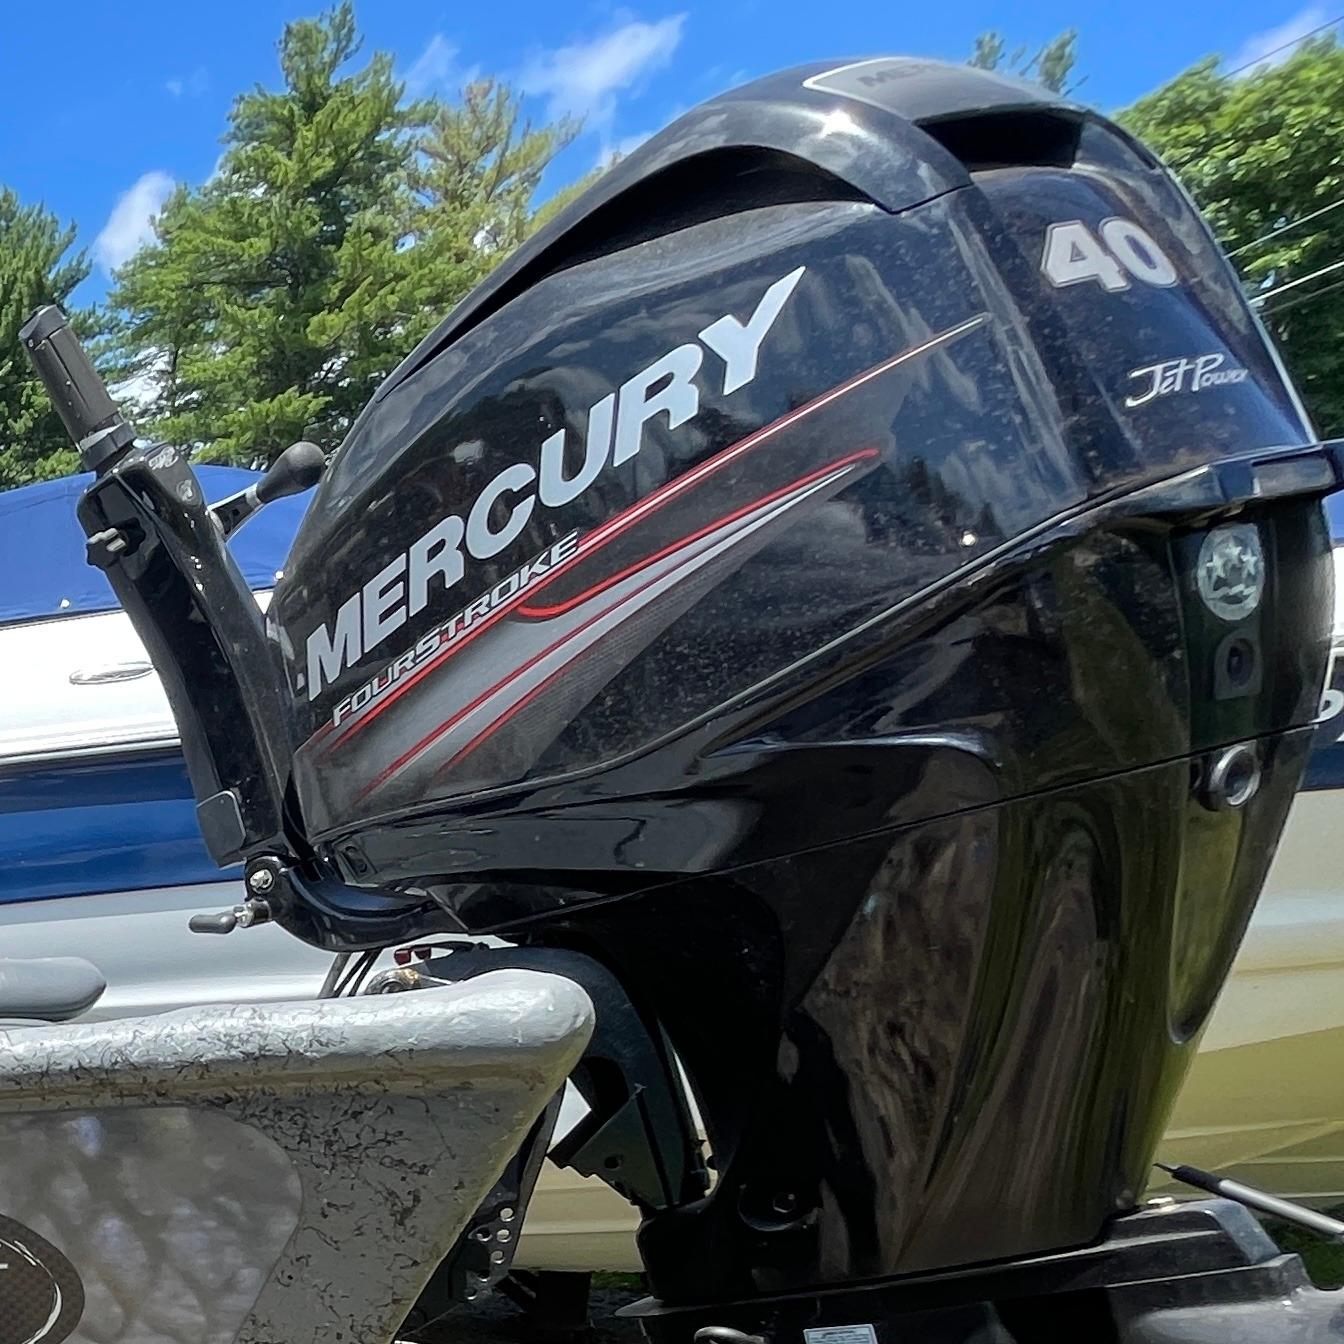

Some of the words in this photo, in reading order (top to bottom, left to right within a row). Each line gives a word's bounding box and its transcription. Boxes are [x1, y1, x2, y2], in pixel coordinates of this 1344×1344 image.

[1043, 218, 1178, 291] 40
[309, 266, 805, 701] MERCURY
[331, 530, 584, 727] FOURSTROKE
